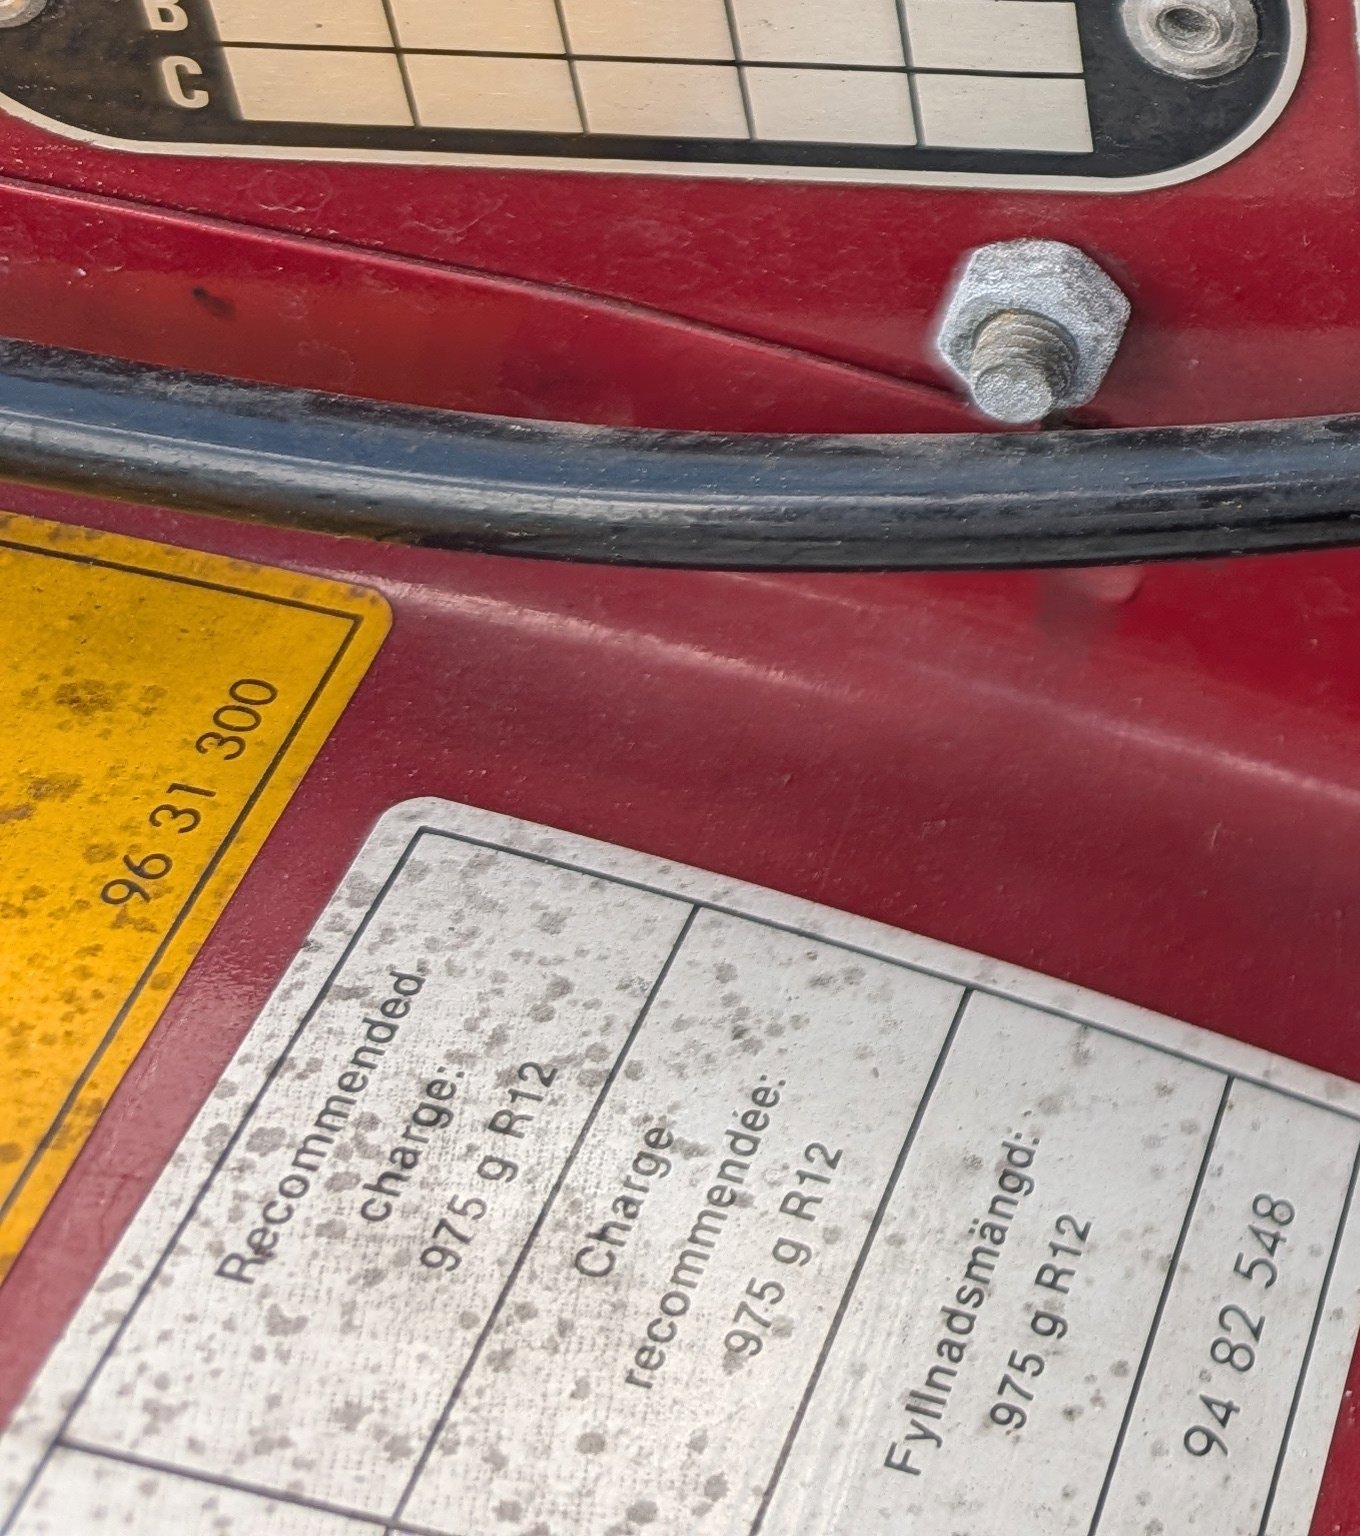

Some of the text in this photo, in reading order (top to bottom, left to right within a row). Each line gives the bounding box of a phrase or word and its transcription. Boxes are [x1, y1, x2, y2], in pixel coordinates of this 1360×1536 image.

[159, 56, 209, 108] C
[100, 678, 278, 906] 96 31 300
[215, 970, 426, 1284] Recommended
[360, 1066, 465, 1222] charge:
[420, 1061, 559, 1272] 975 g R12
[574, 1127, 674, 1278] Charge
[625, 1074, 786, 1389] recommendée:
[724, 1142, 843, 1356] 975 g R12
[884, 1132, 1040, 1476] Fyllnadsmängd:
[990, 1214, 1092, 1429] 975 g R12
[1183, 1193, 1295, 1456] 94 82 548
